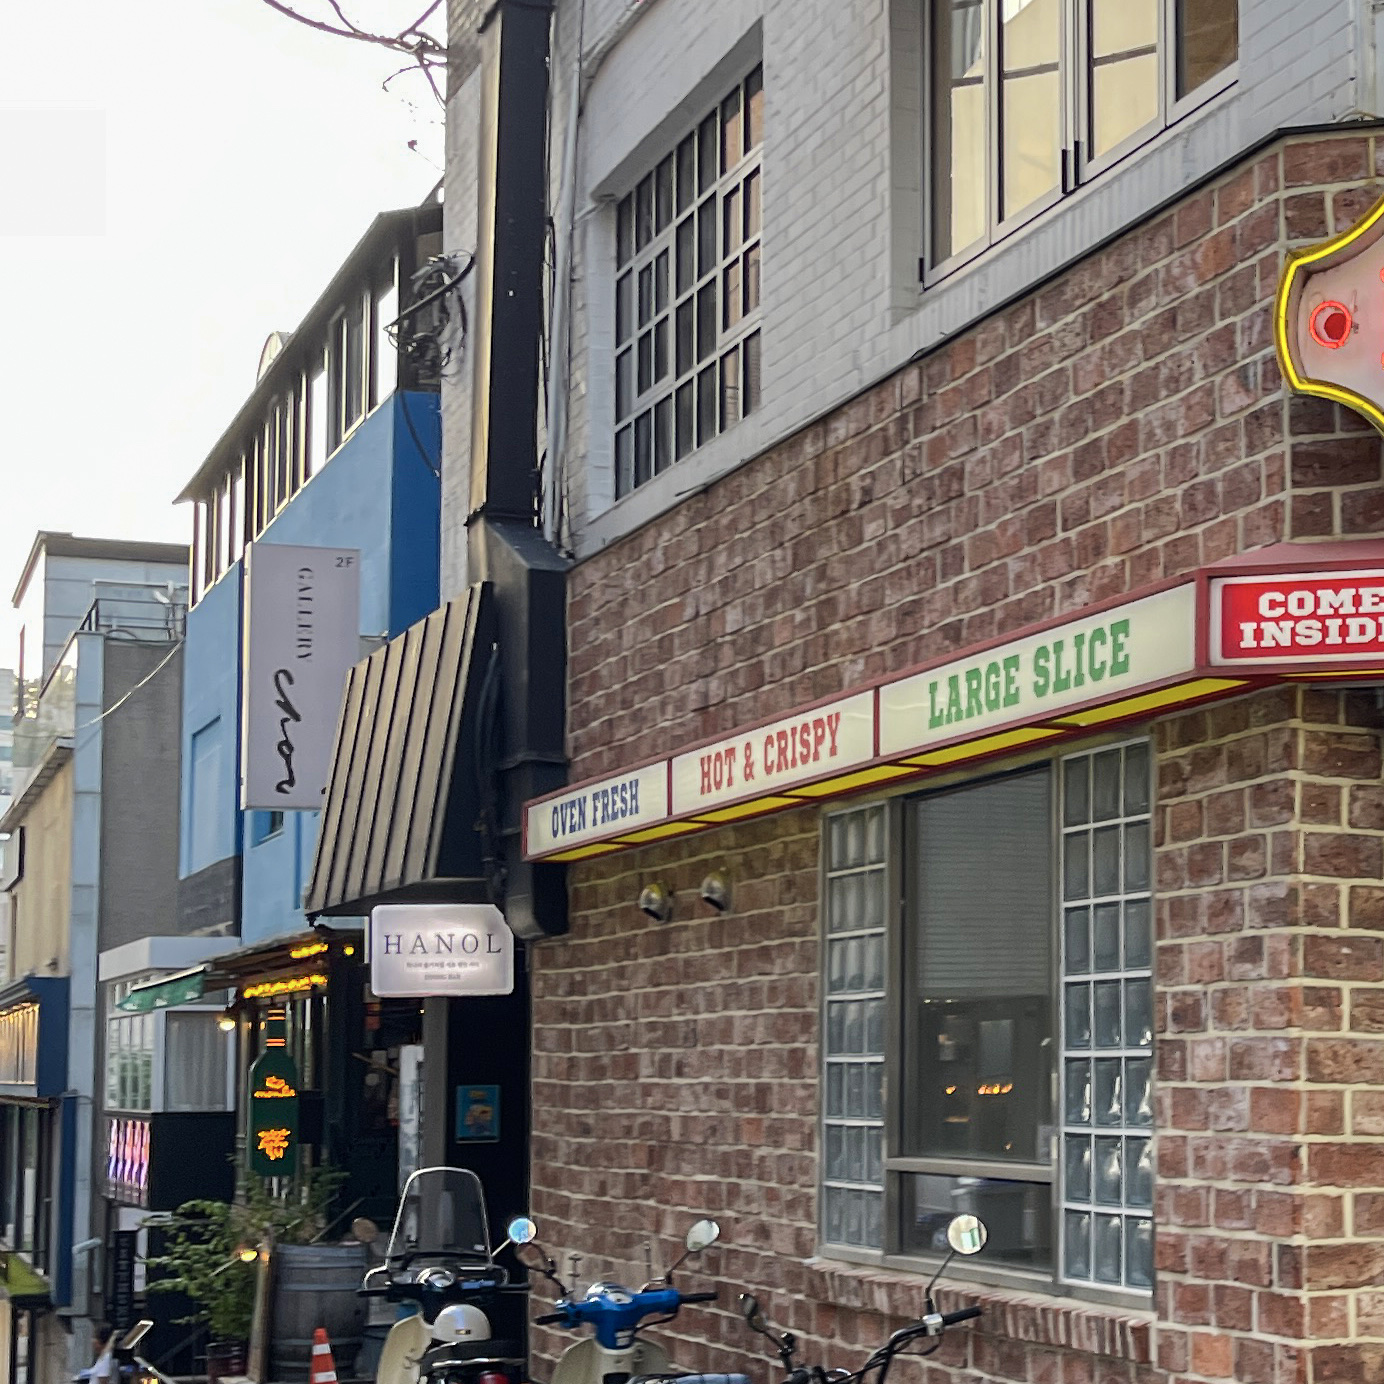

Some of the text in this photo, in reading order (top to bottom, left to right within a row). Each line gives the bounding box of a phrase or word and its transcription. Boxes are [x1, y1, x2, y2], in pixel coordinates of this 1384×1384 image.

[335, 556, 354, 568] 2F
[297, 567, 314, 663] GALLERY
[928, 618, 1130, 730] LARGE SLICE
[700, 711, 842, 796] HOT & CRISPY
[551, 778, 640, 839] OVEN FRESH
[383, 932, 502, 955] HANOL
